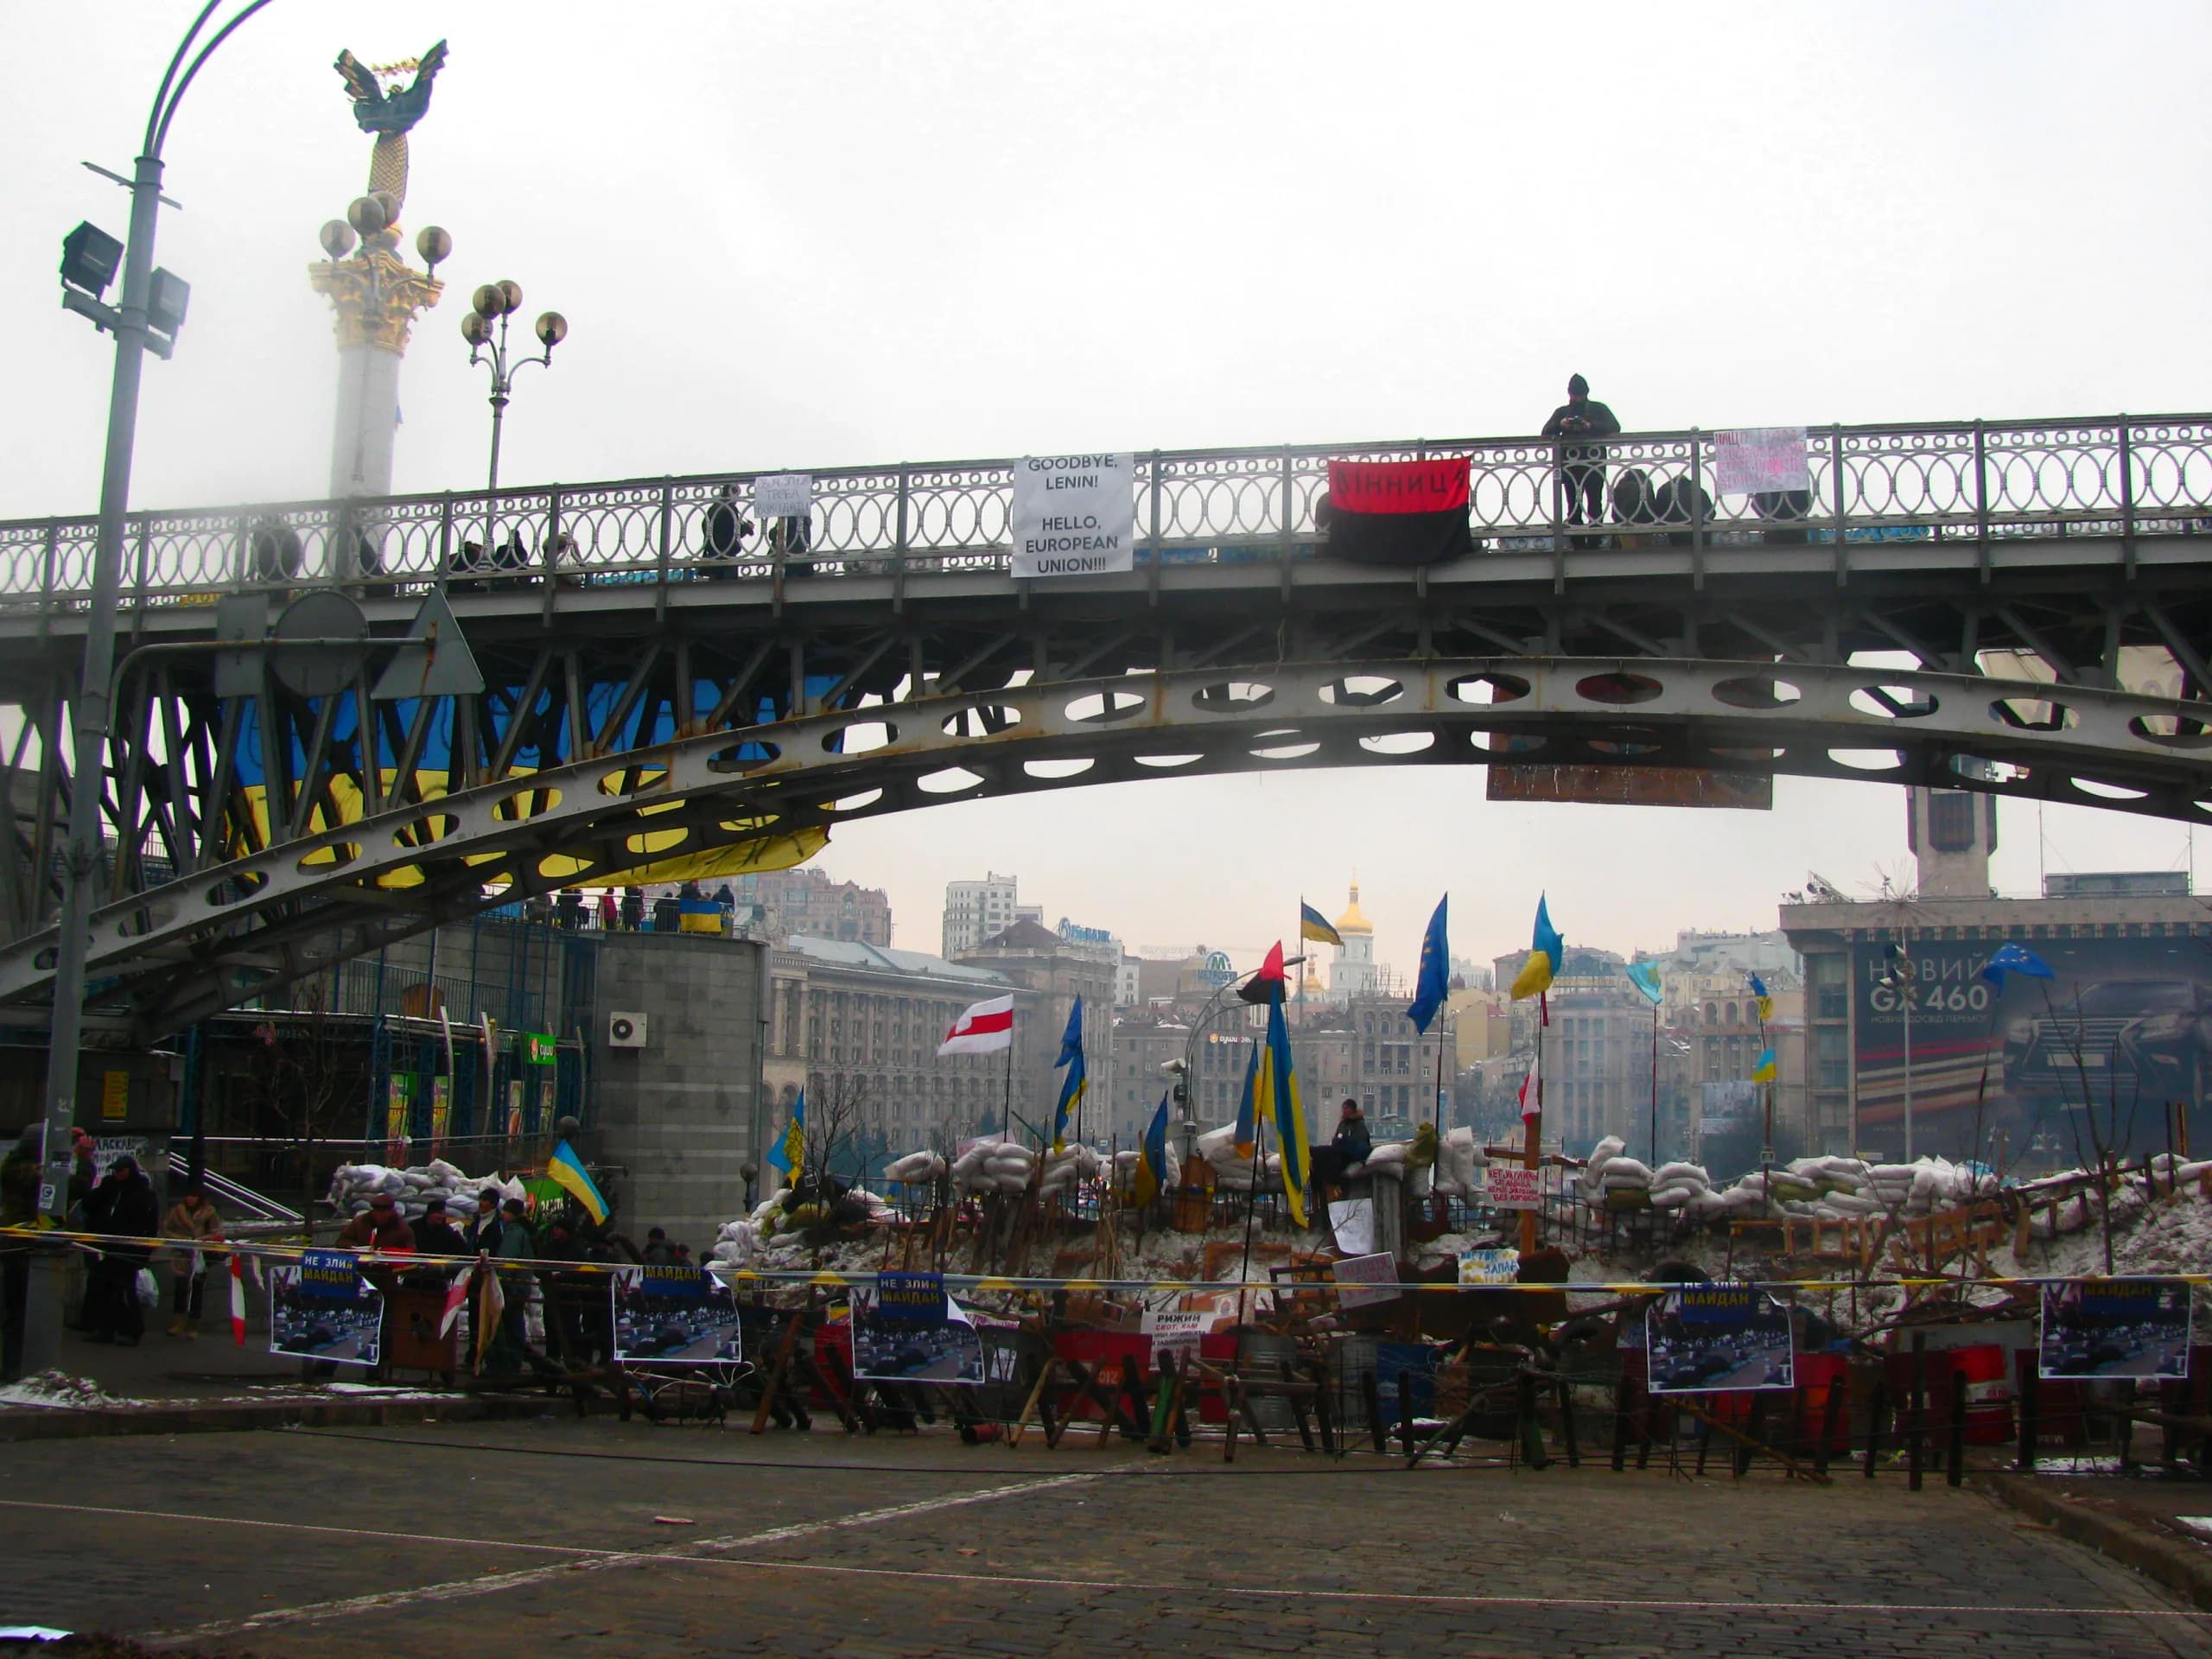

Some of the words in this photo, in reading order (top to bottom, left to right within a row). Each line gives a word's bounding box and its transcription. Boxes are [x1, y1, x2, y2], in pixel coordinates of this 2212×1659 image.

[1028, 454, 1118, 472] GOODBYE,
[1046, 475, 1098, 491] LENIN!
[1335, 468, 1466, 495] ВІННИЦЯ
[1042, 515, 1102, 531] HELLO,
[1026, 536, 1118, 554] EUROPEAN
[1037, 557, 1107, 574] UNION!!!
[1925, 985, 1988, 1011] 460
[304, 1256, 319, 1265] НЕ
[303, 1268, 353, 1283] МАЙДАН
[645, 1266, 702, 1281] МАЙДАН
[880, 1279, 898, 1287] НЕ
[880, 1291, 941, 1306] МАЙДАН
[1683, 1292, 1751, 1306] МАЙДАН
[1157, 1314, 1201, 1323] РИЖИЙ
